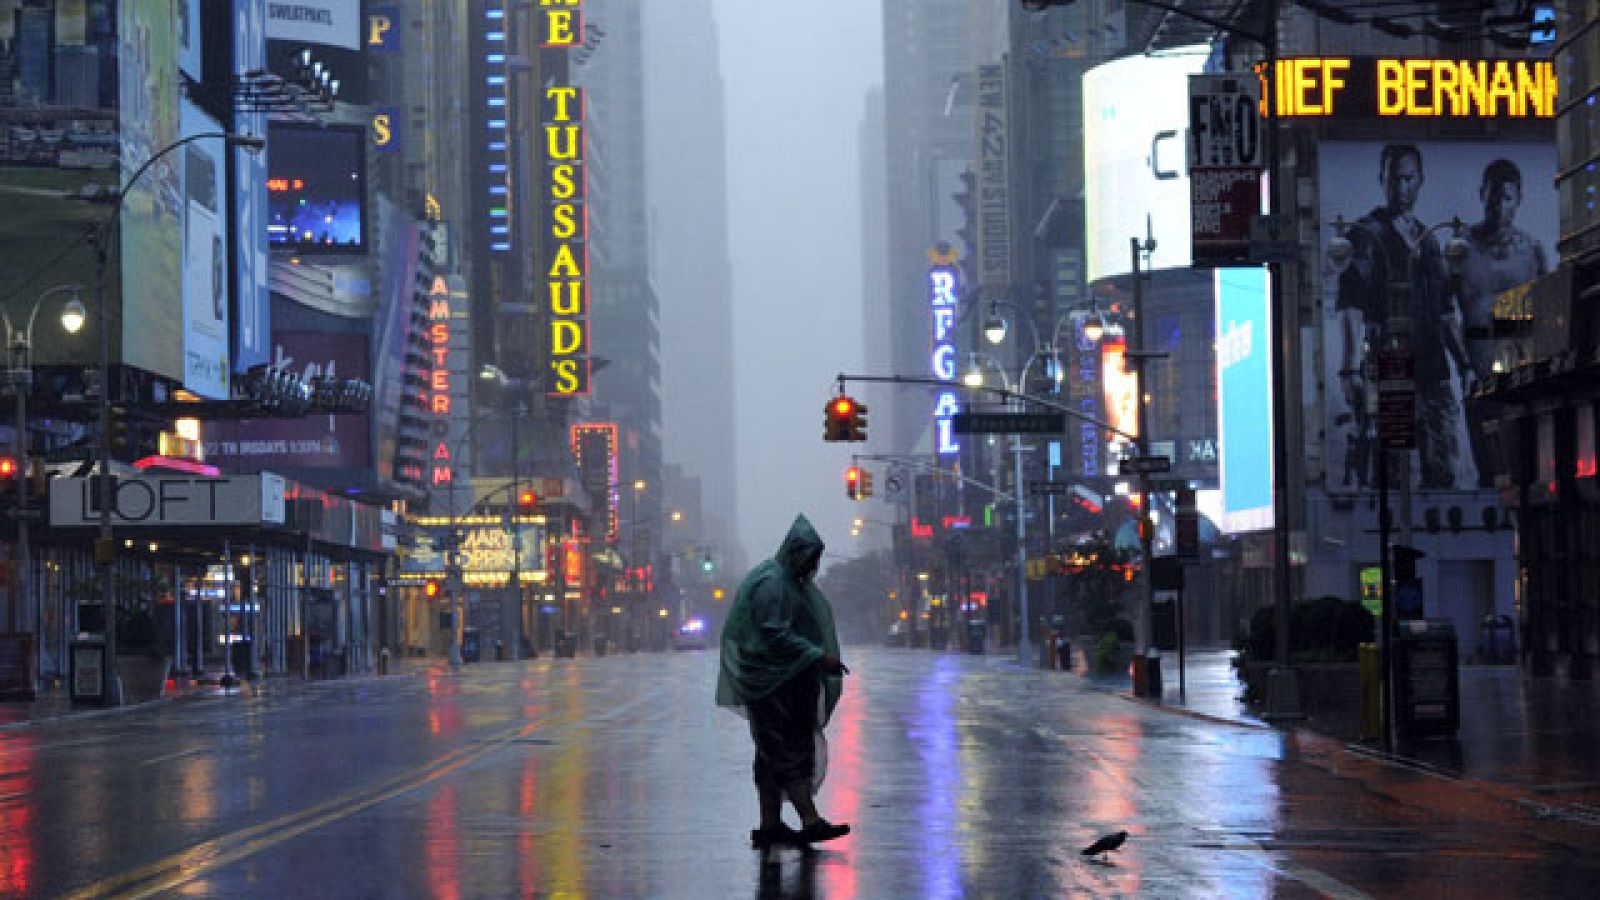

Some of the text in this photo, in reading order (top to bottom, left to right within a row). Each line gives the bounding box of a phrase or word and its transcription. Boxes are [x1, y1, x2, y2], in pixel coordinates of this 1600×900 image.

[368, 15, 391, 45] P
[539, 0, 582, 394] E TUSSAUD'S
[81, 479, 231, 521] LOFT
